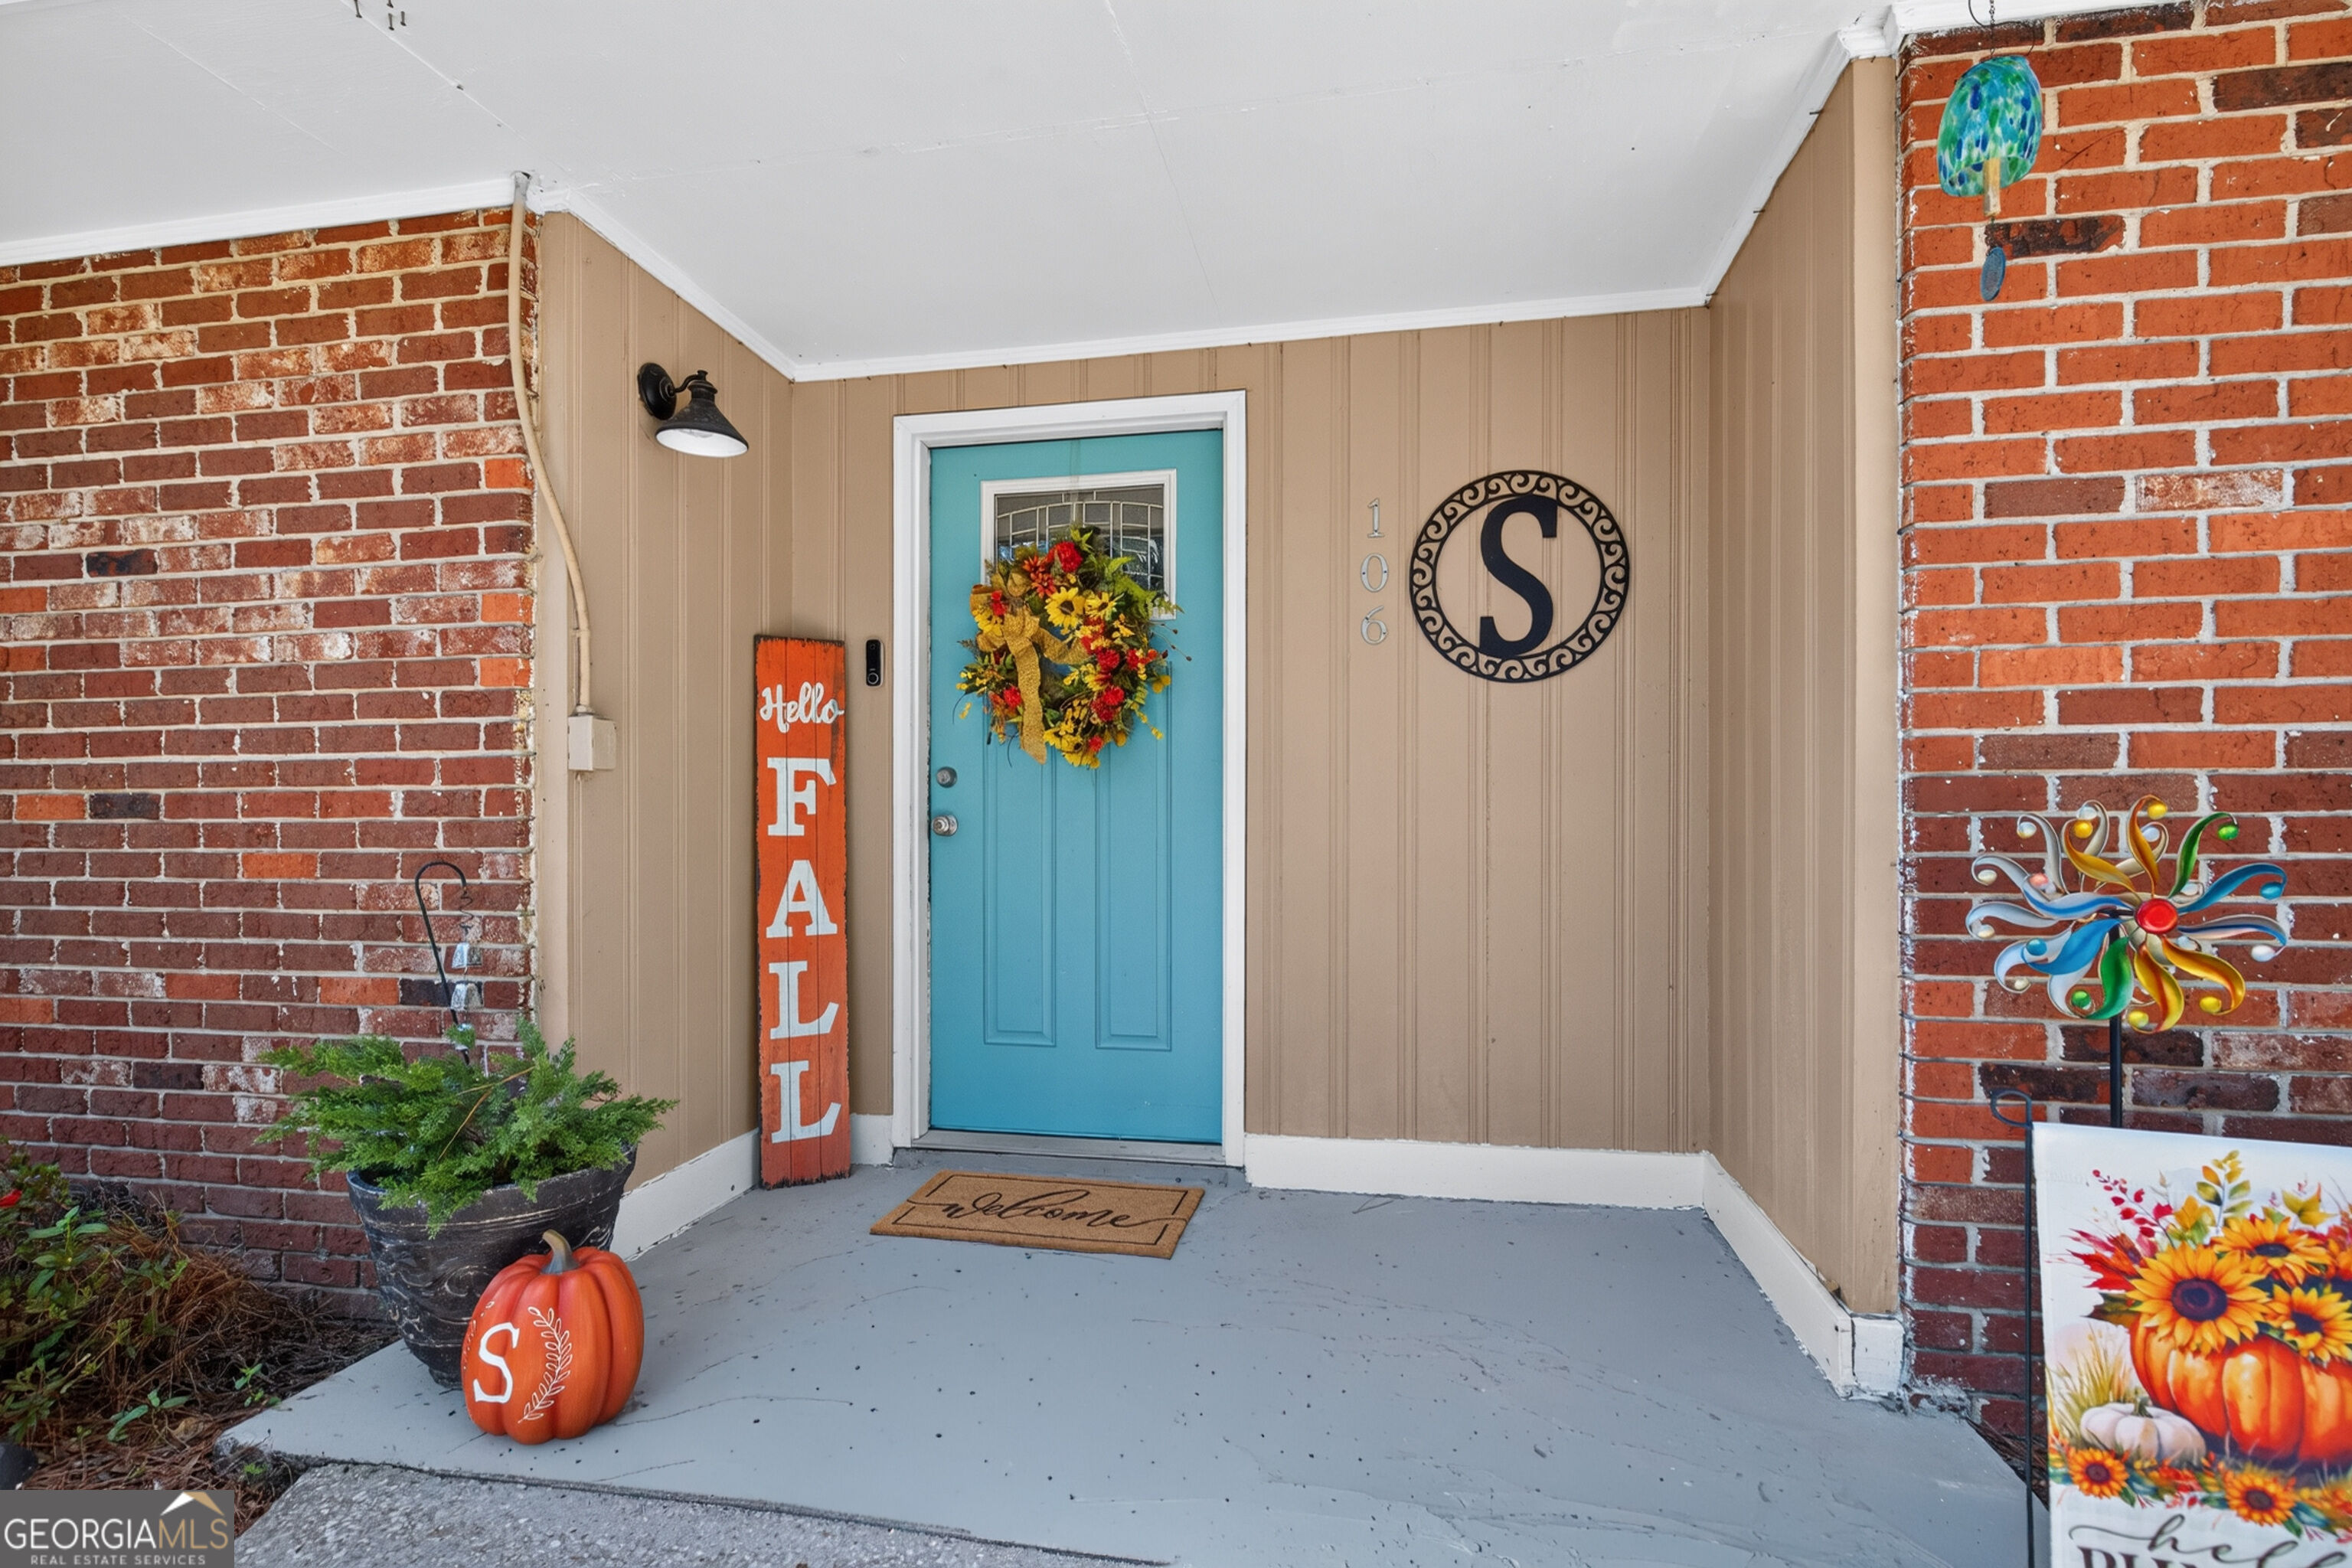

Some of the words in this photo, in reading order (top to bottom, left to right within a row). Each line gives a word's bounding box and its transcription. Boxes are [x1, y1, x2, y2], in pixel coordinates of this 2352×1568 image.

[1360, 498, 1390, 645] 106
[1479, 494, 1558, 657] S
[760, 681, 844, 733] Hello
[766, 757, 841, 1144] FALL
[472, 1321, 520, 1404] S
